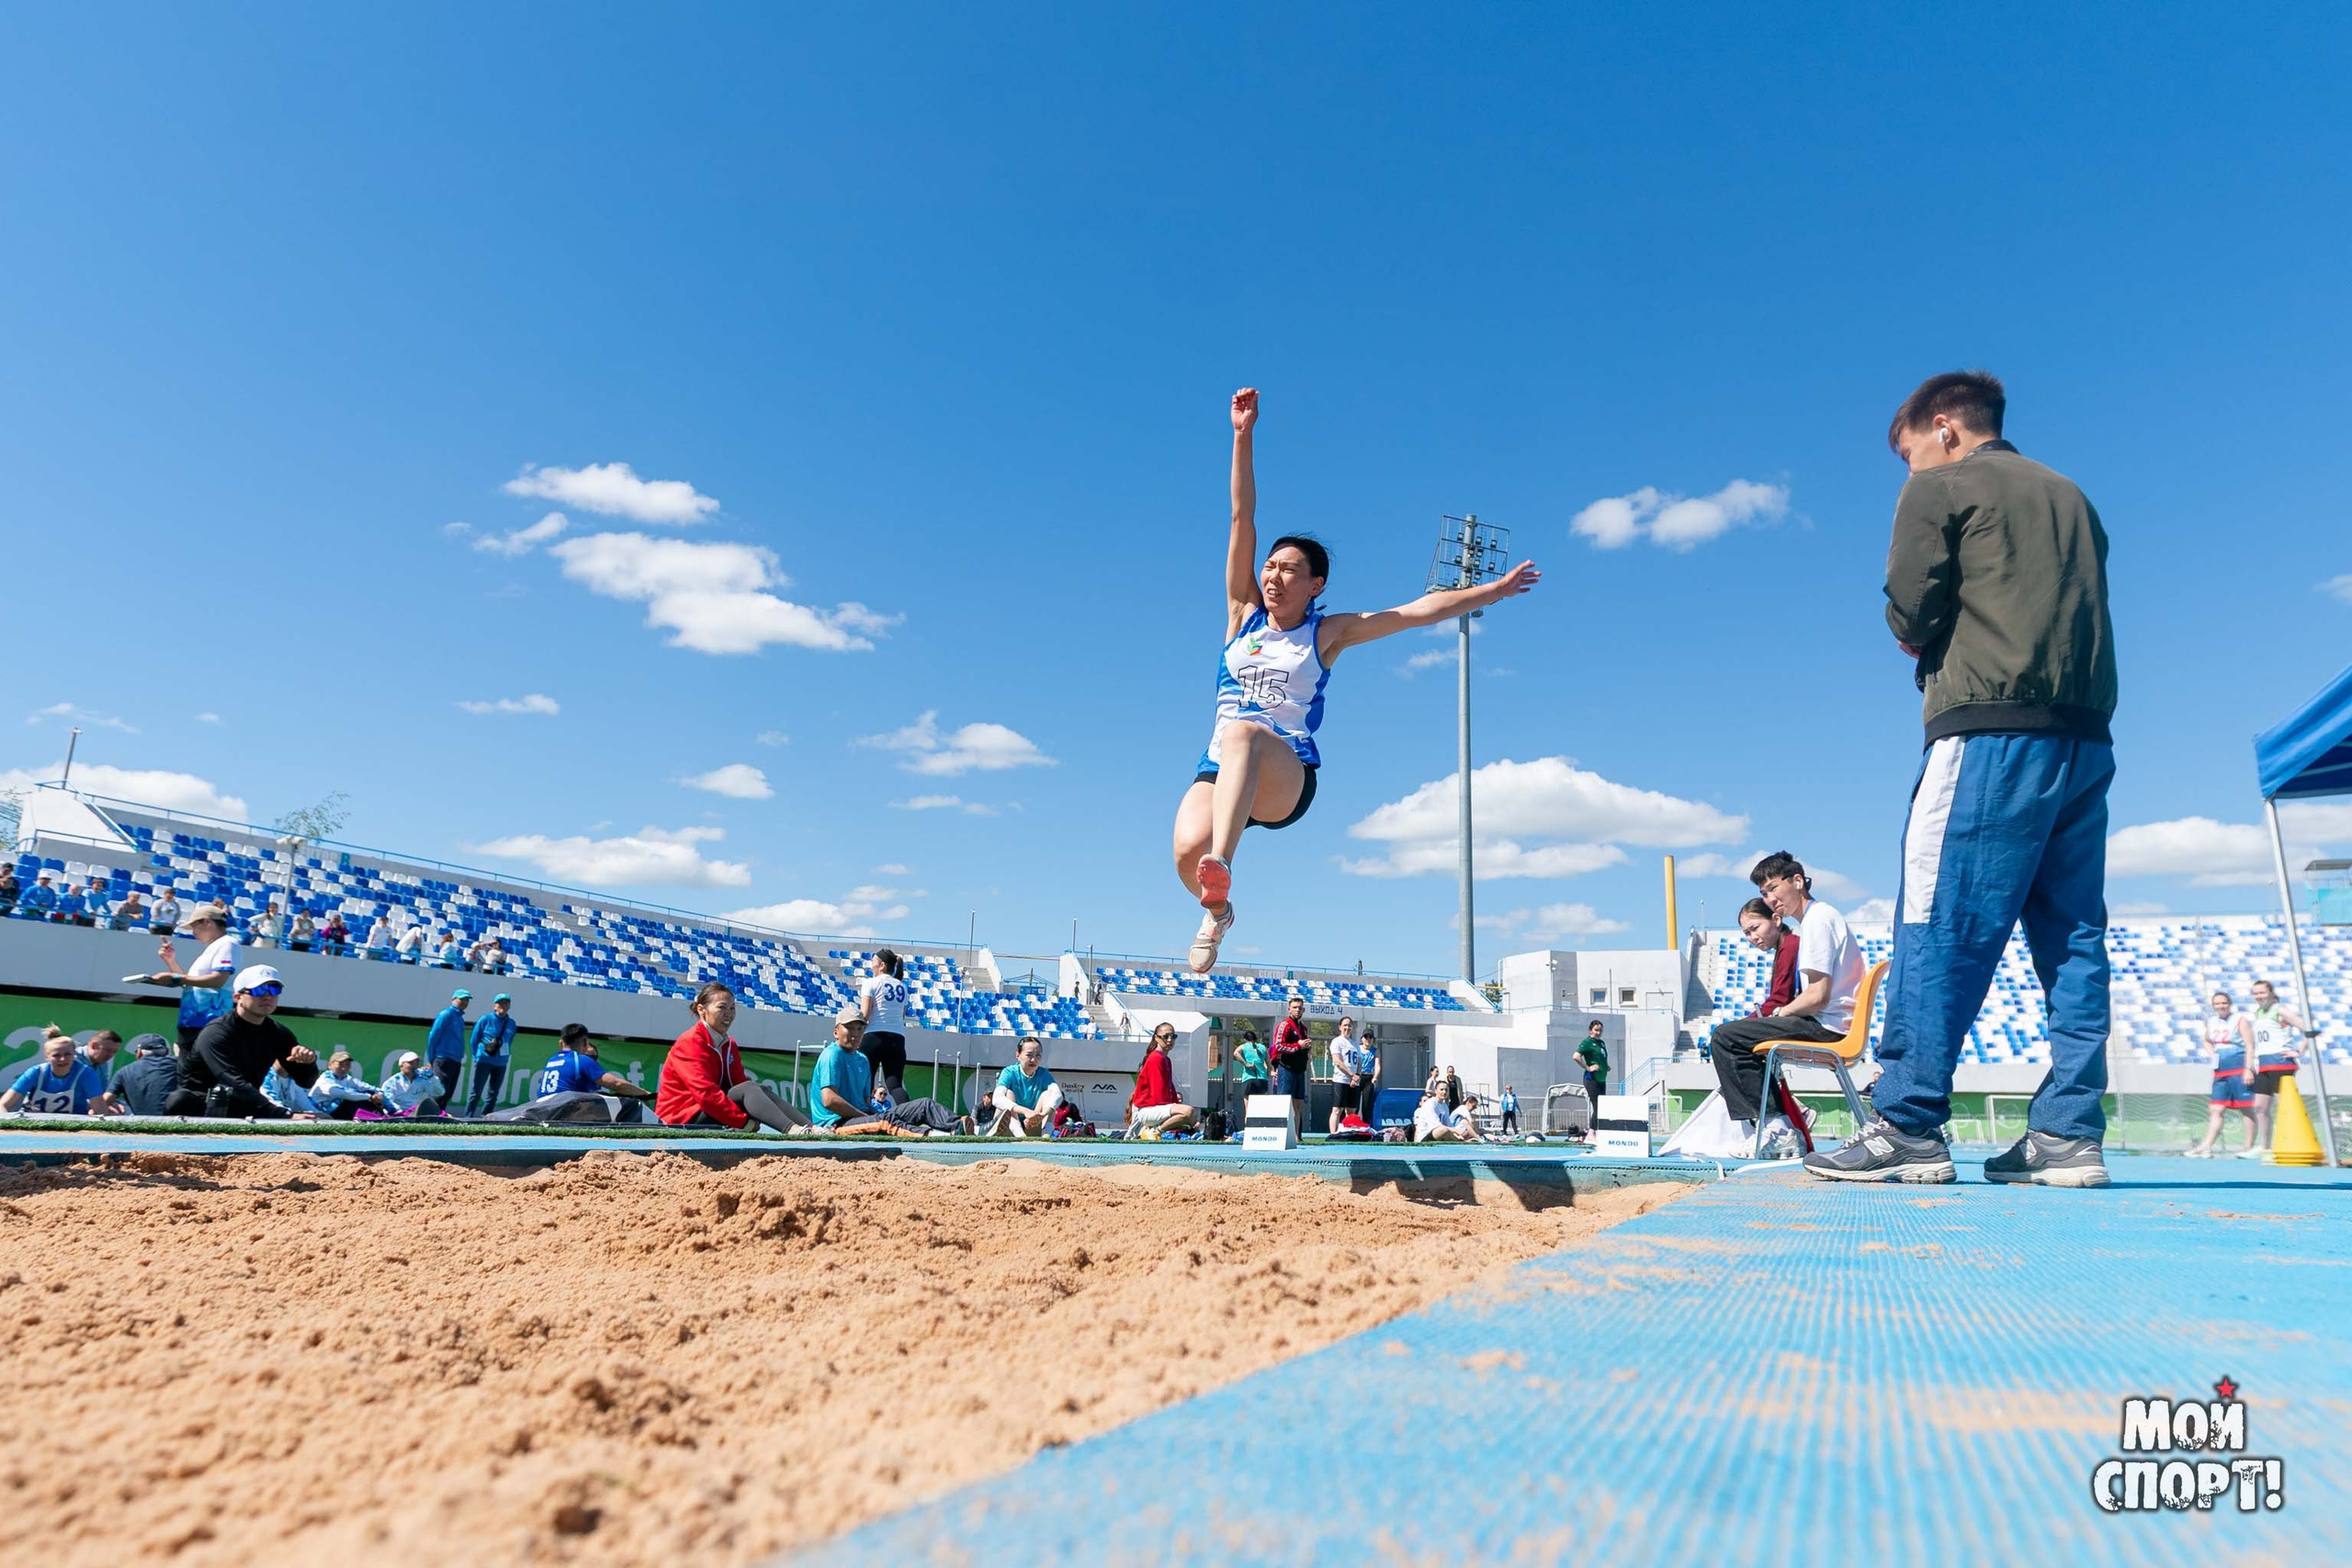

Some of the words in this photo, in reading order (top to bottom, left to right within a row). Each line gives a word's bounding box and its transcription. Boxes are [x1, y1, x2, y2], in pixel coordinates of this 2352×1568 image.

[1237, 664, 1290, 710] 15
[884, 983, 905, 1003] 39
[1310, 1004, 1335, 1015] ВЫХОД
[1345, 1049, 1358, 1066] 16
[541, 1069, 560, 1093] 13
[34, 1095, 71, 1113] 12
[1863, 1135, 1894, 1156] N
